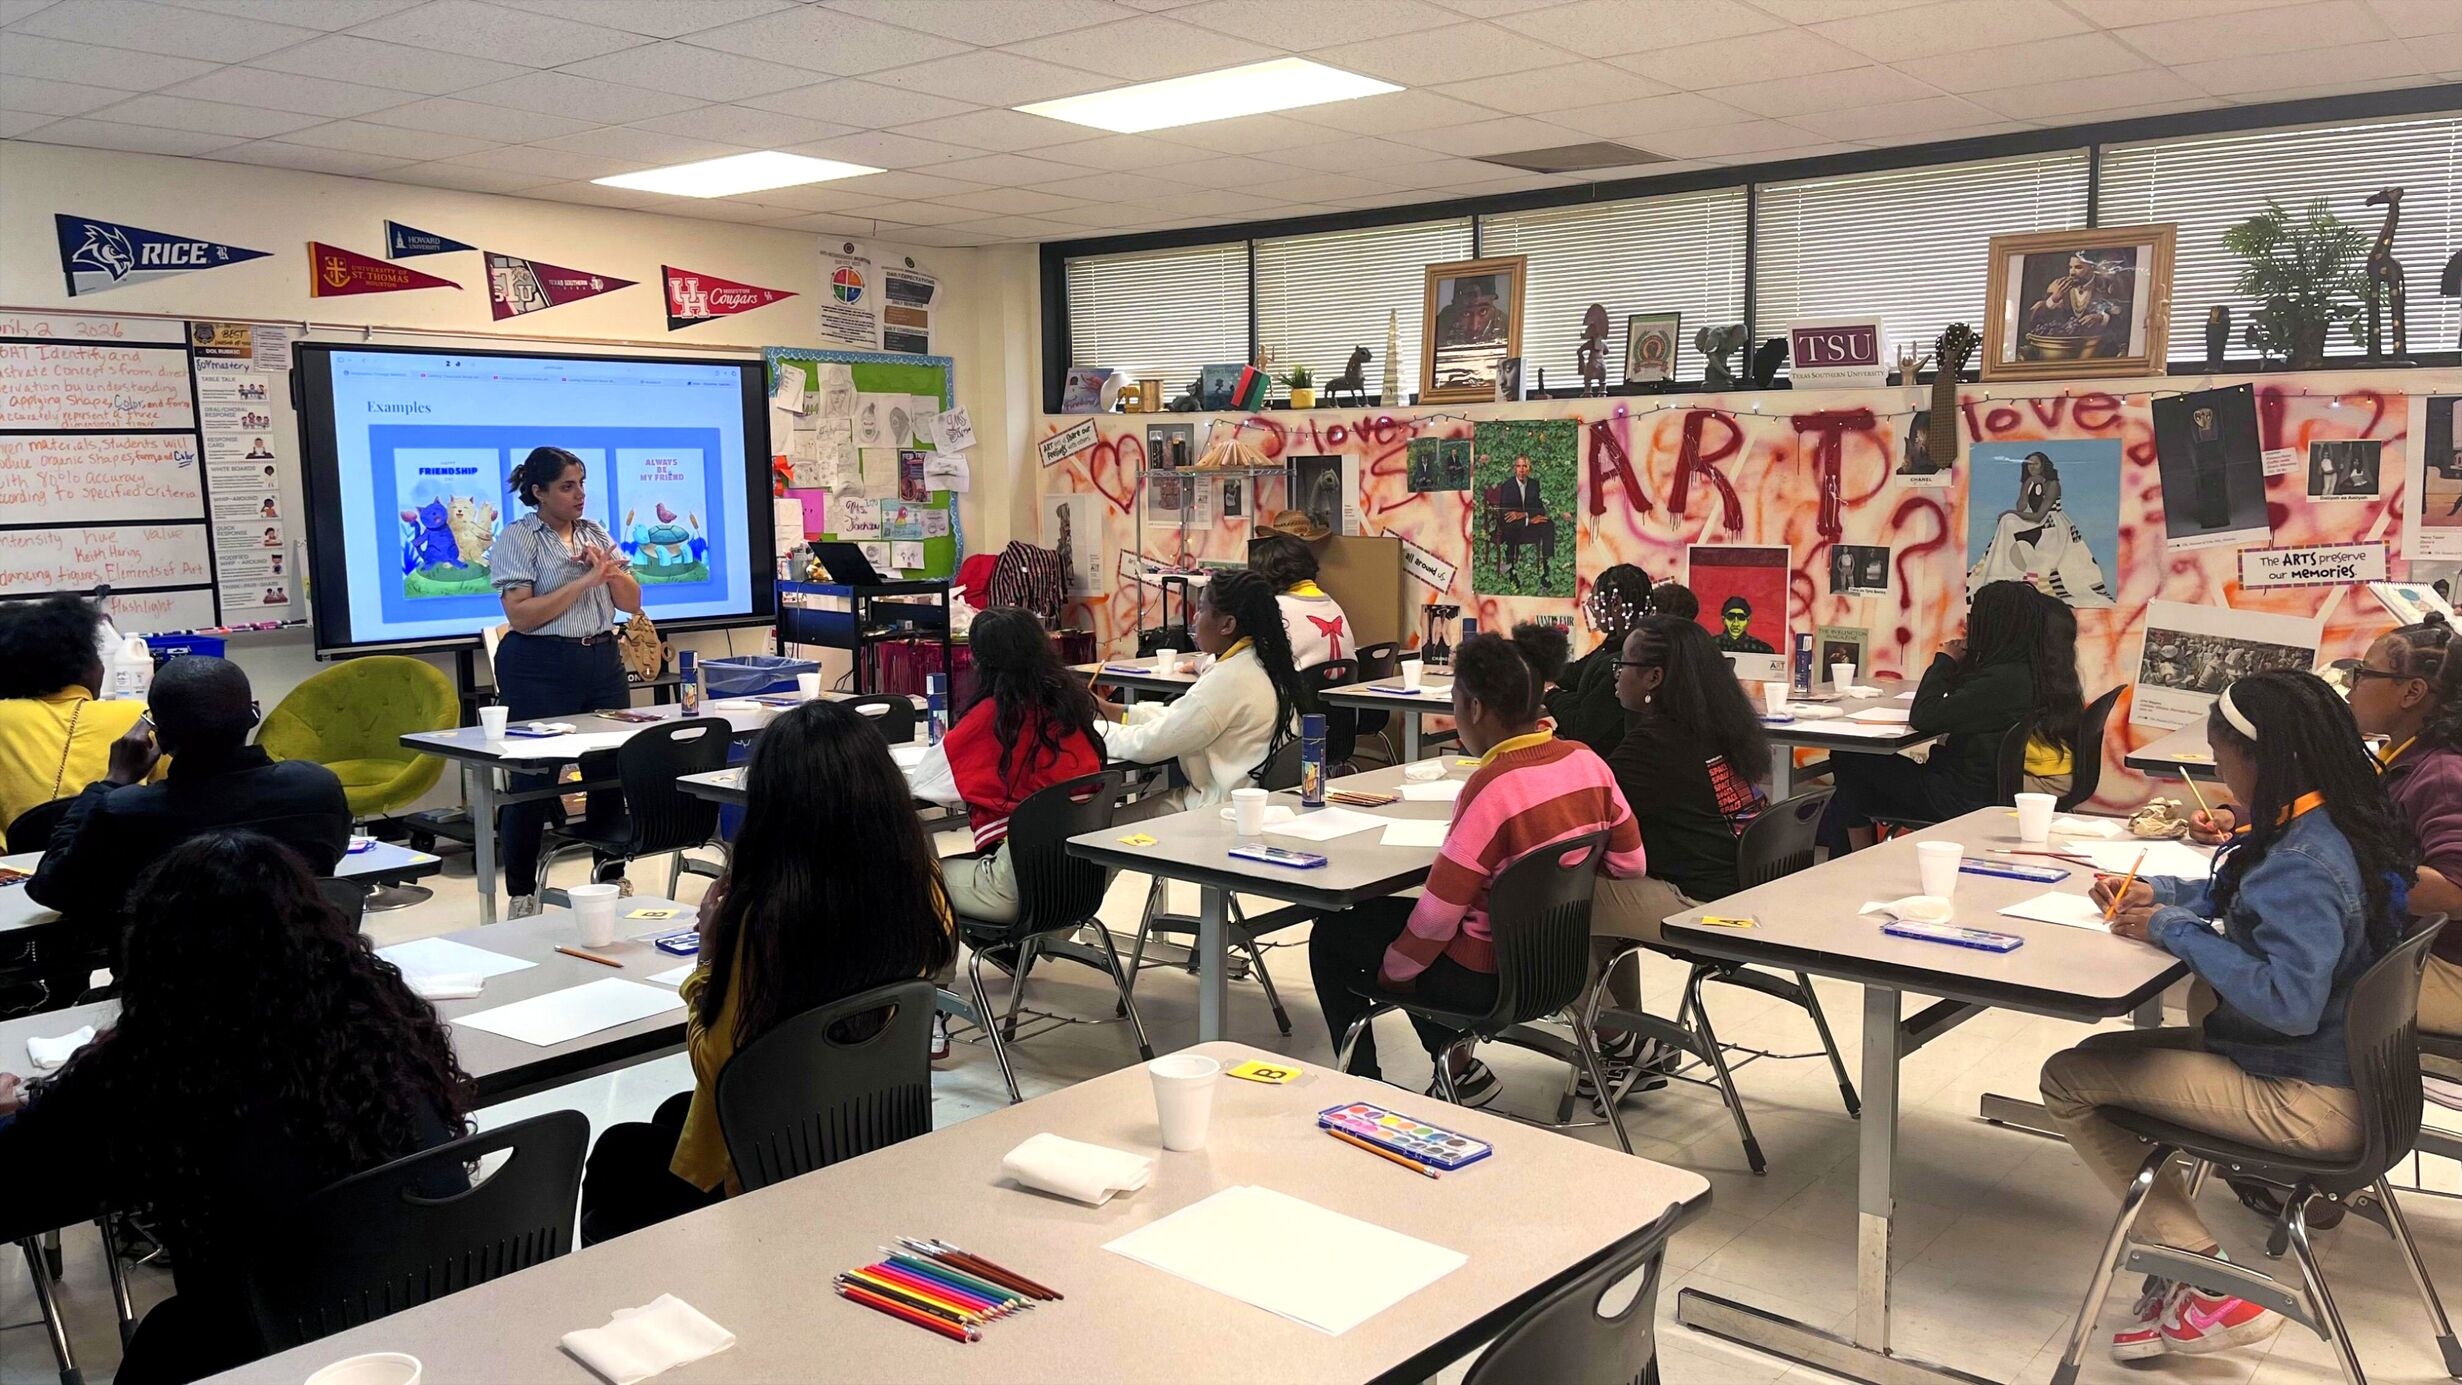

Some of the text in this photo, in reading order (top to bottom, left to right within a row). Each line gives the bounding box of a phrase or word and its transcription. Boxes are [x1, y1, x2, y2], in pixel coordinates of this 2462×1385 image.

[408, 236, 440, 245] HOWARD
[141, 242, 209, 265] RICE
[352, 265, 396, 274] UNIVERSITY
[367, 272, 409, 284] THOMAS
[669, 278, 711, 318] UH
[710, 287, 758, 309] Cougars
[75, 321, 124, 337] 2026
[1798, 333, 1872, 361] TSU
[1847, 370, 1885, 378] UNIVERSITY
[367, 401, 432, 415] Examples
[1962, 391, 2123, 442] love
[418, 467, 478, 476] FRIENDSHIP
[1589, 408, 1876, 540] ART
[1405, 551, 1415, 563] all
[1414, 557, 1438, 576] around
[2260, 551, 2366, 567] The ARTS preserve
[2269, 572, 2287, 580] our
[1252, 1068, 1287, 1079] B
